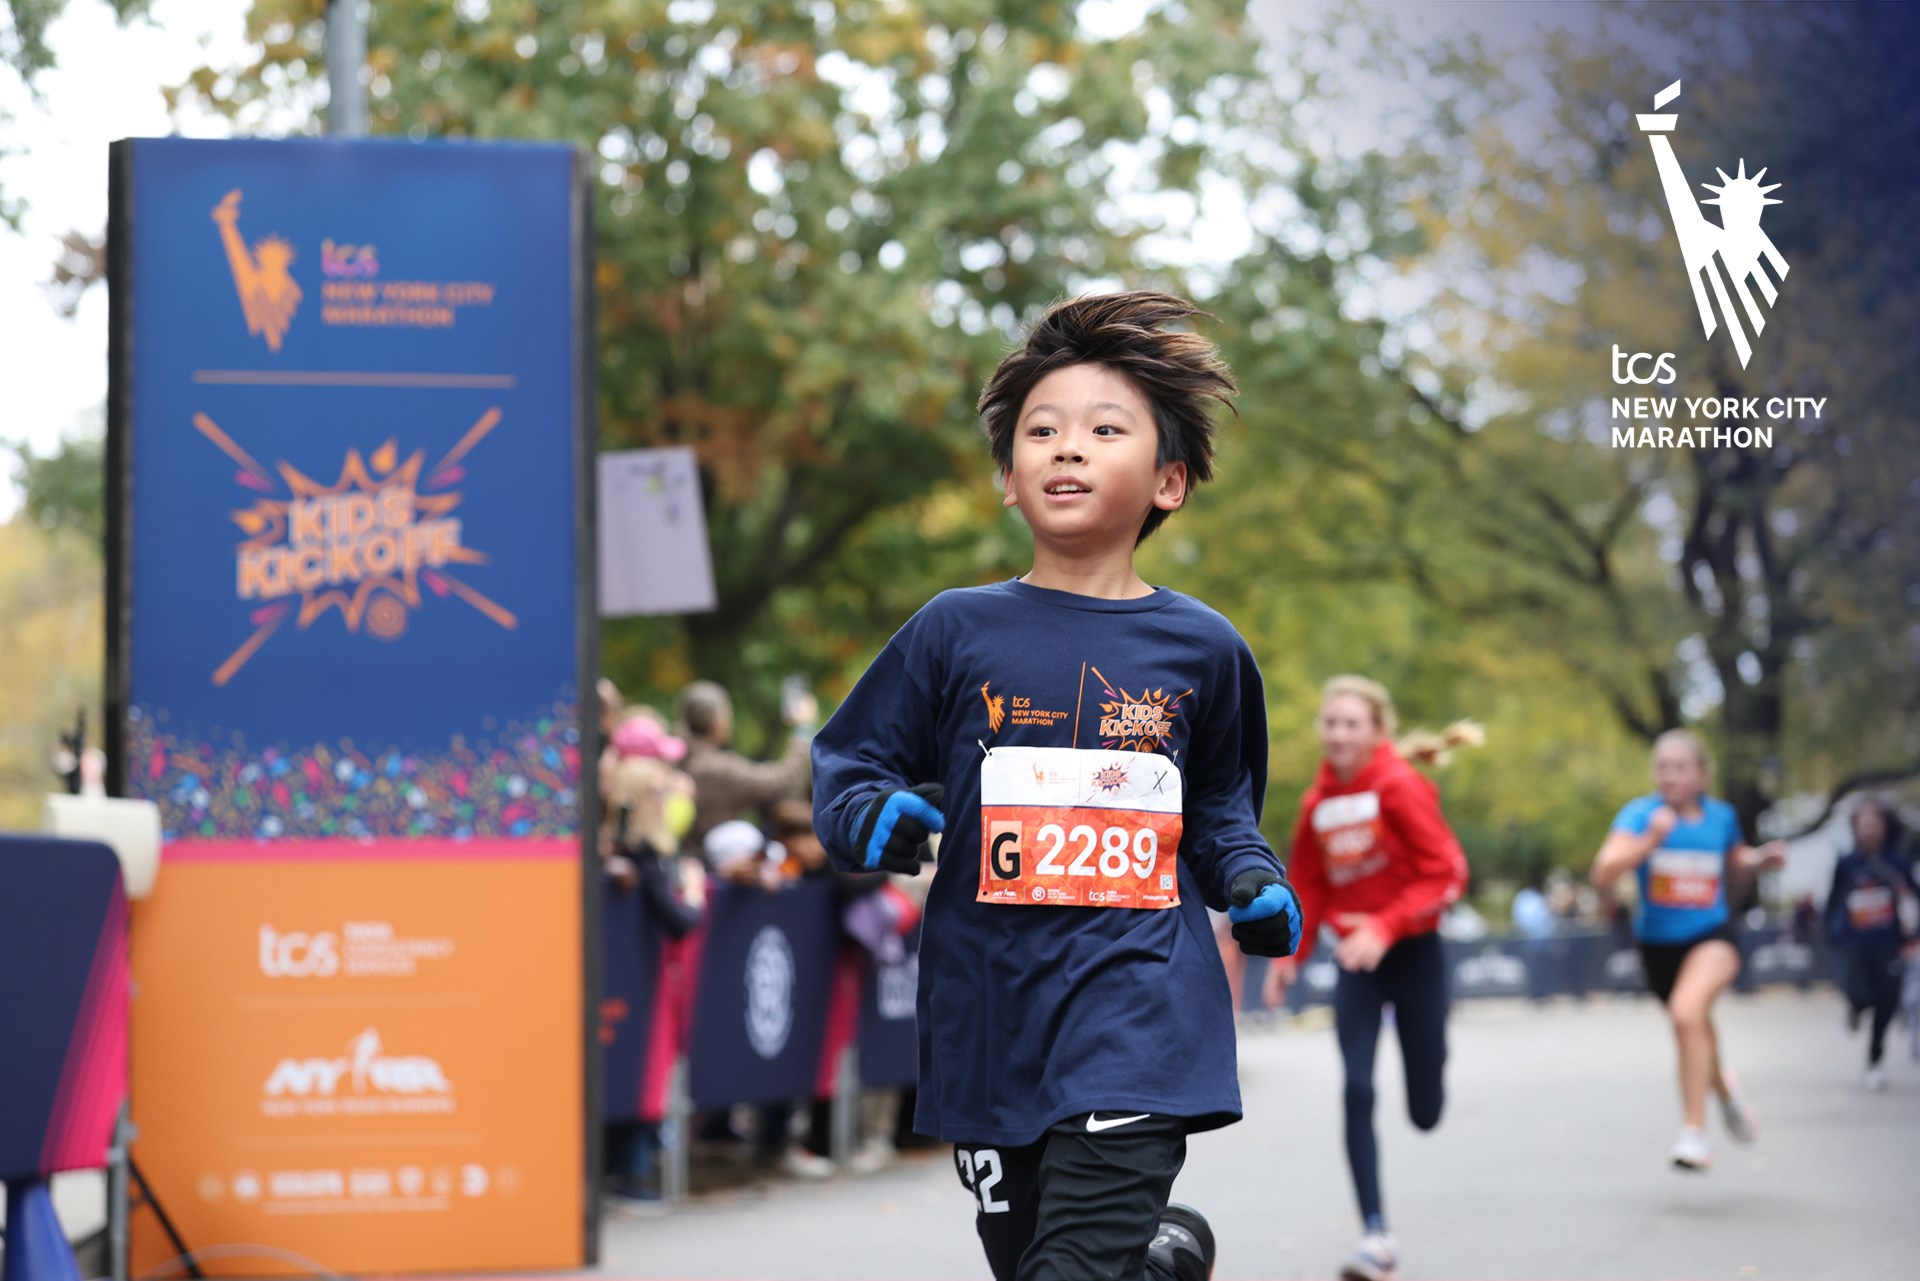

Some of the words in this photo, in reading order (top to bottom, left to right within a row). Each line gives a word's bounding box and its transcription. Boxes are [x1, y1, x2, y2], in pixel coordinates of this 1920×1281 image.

[321, 237, 380, 278] tcs
[289, 484, 415, 543] KIDS
[1012, 695, 1031, 708] tcs
[1011, 709, 1030, 717] NEW
[1030, 710, 1051, 718] YORK
[1051, 711, 1069, 720] CITY
[1121, 703, 1164, 721] KIDS
[1011, 717, 1054, 726] MARATHON
[1099, 720, 1172, 737] KICKOFF
[991, 832, 1020, 880] G
[1035, 824, 1158, 879] 2289
[1089, 890, 1106, 902] tcs
[259, 922, 340, 978] tcs
